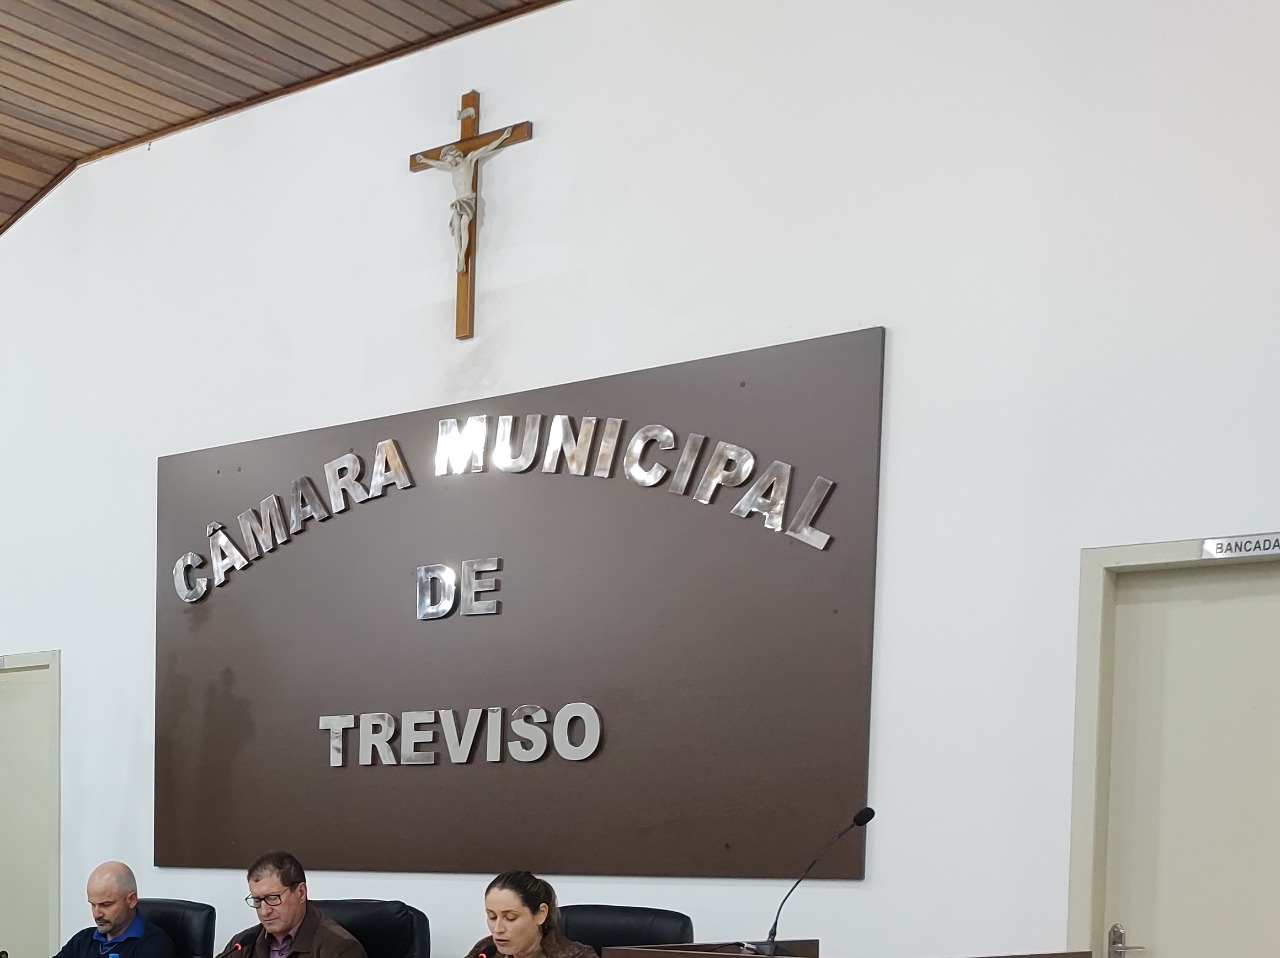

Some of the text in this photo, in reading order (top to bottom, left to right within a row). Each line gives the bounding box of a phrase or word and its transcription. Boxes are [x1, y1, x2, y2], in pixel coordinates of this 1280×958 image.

[172, 413, 836, 603] CÂMARA MUNICIPAL
[1215, 537, 1280, 555] BANCADA
[416, 557, 502, 621] DE
[319, 702, 602, 768] TREVISO
